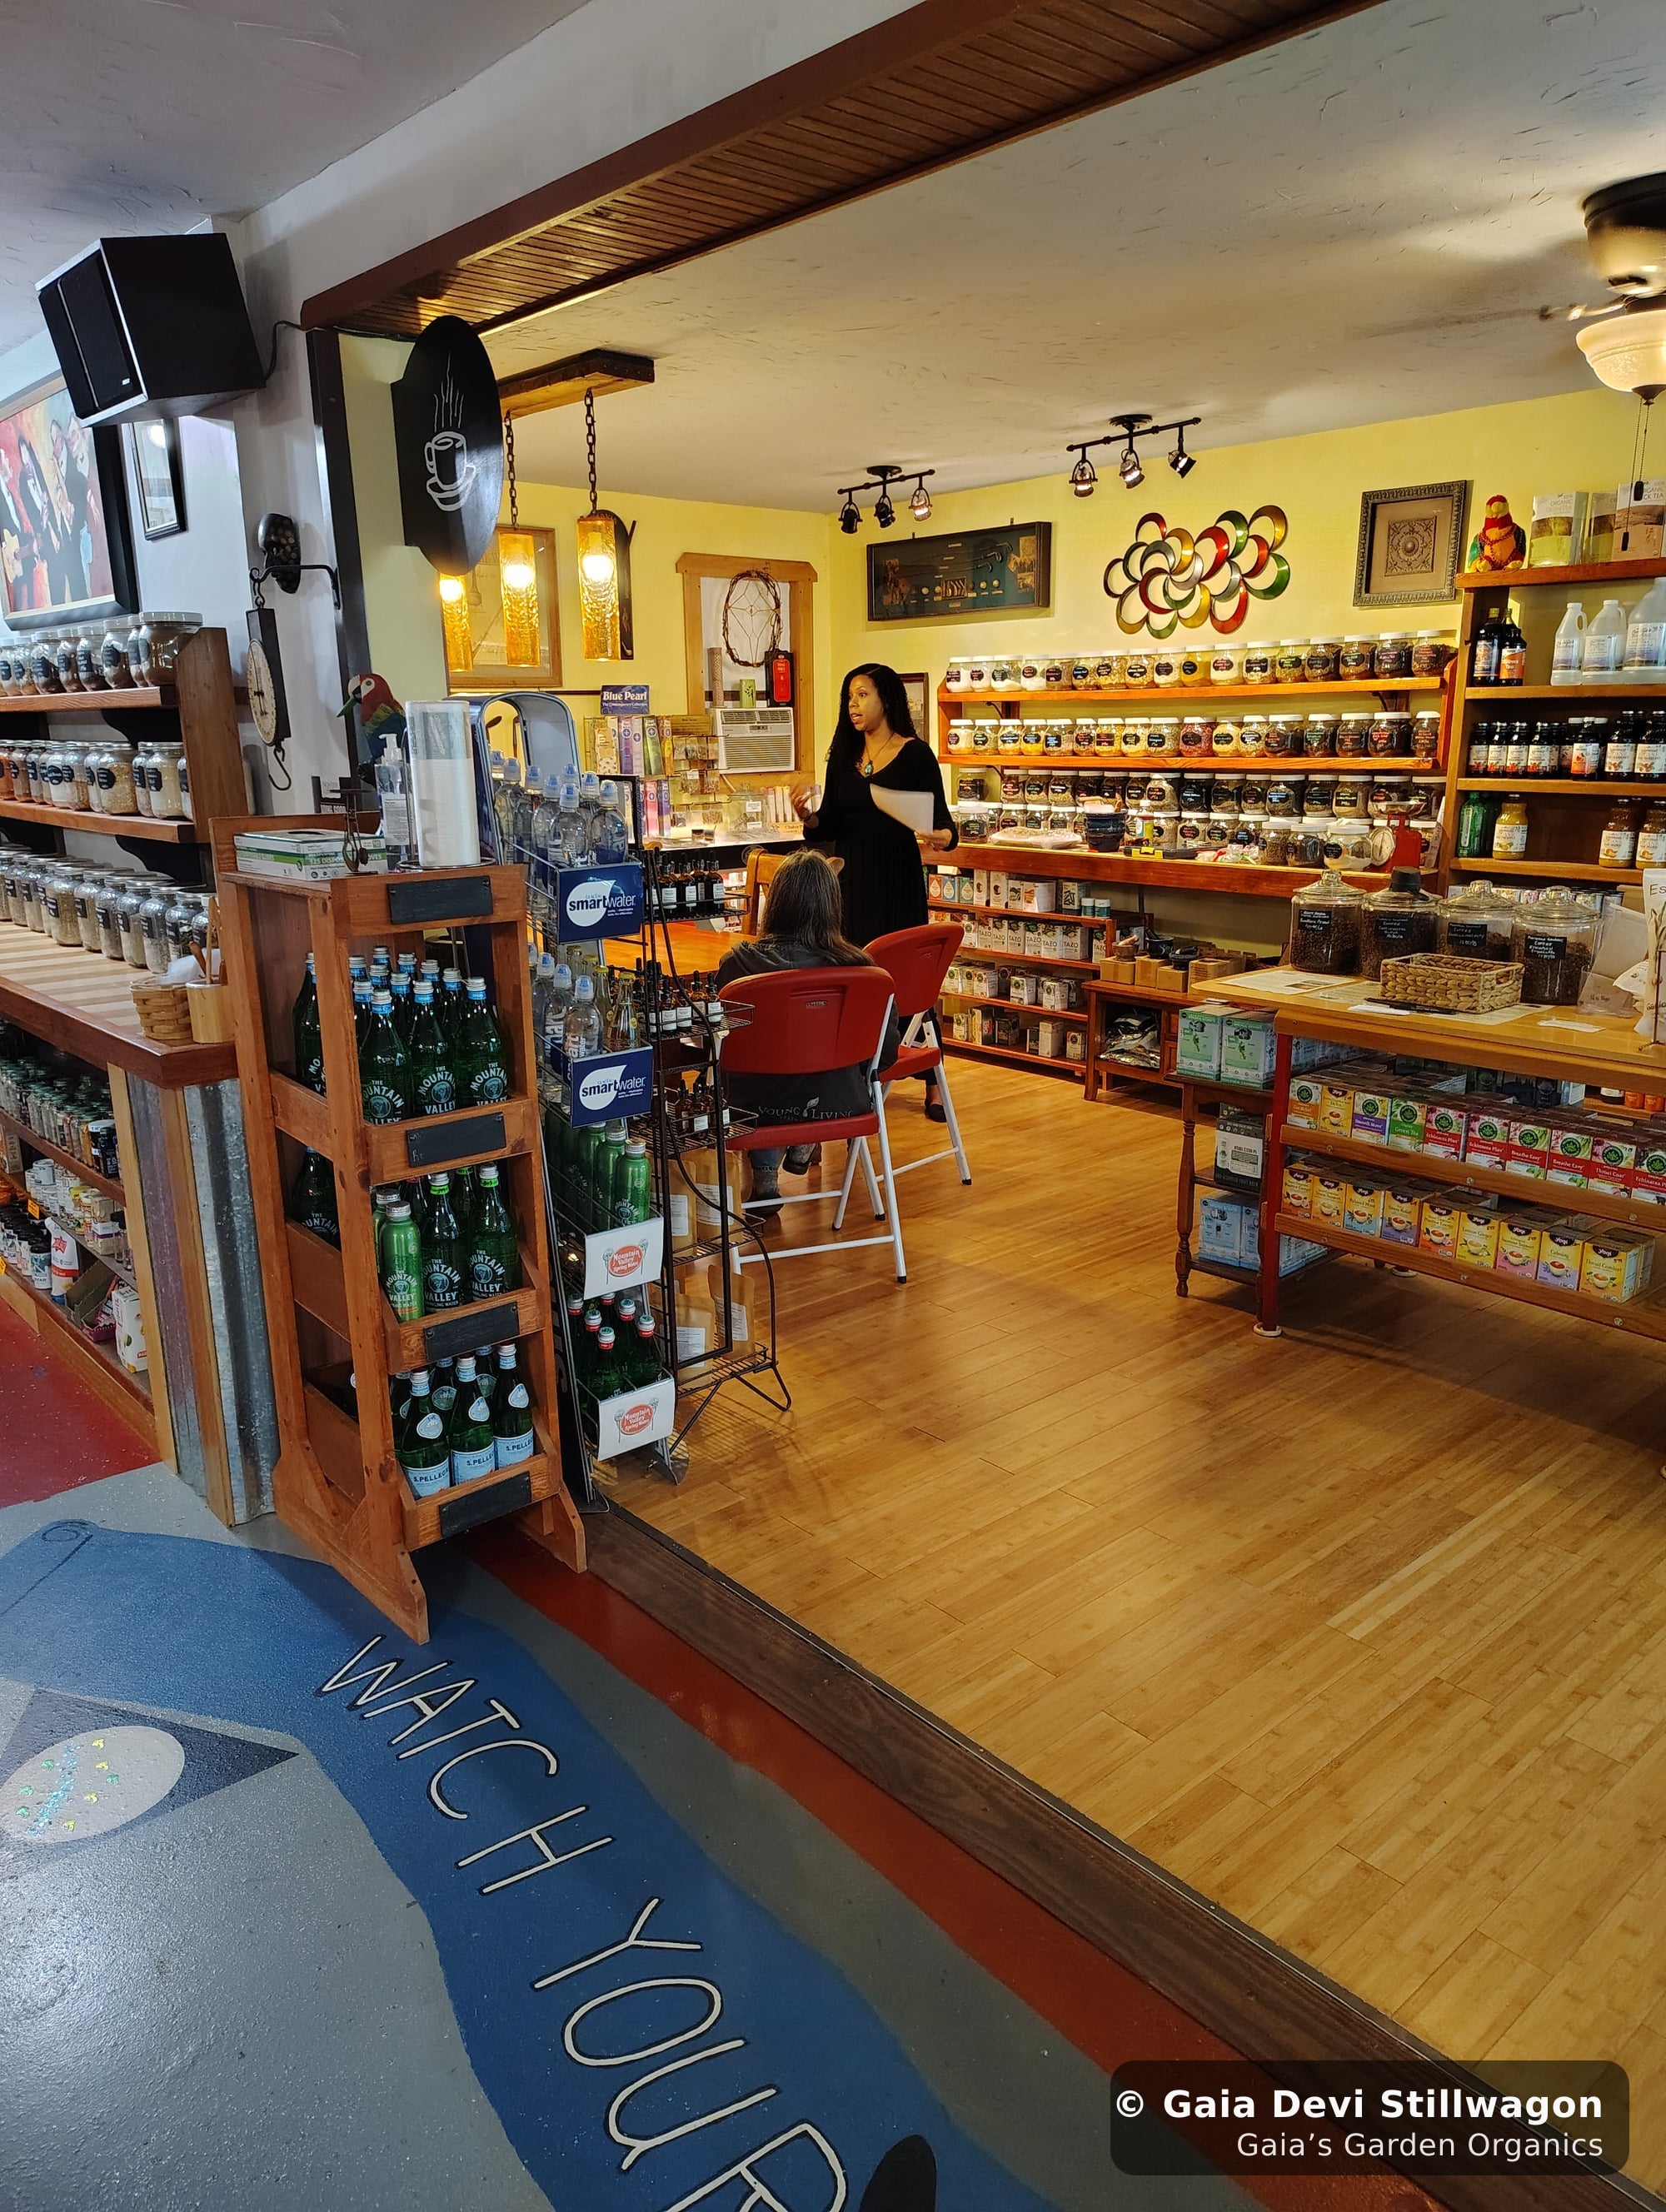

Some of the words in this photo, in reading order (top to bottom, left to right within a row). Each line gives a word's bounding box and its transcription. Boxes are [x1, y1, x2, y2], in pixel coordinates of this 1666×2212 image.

[602, 691, 623, 700] Blue
[624, 691, 647, 700] Pearl
[569, 894, 636, 911] smartwater
[581, 1077, 646, 1097] smartwater
[362, 1085, 405, 1108] OUNTAIN
[425, 1101, 456, 1114] VALLEY
[758, 1106, 801, 1116] YOUNG
[1511, 1150, 1529, 1158] Breathe
[1553, 1158, 1571, 1168] Breathe
[1595, 1168, 1611, 1176] Throat
[1434, 1207, 1447, 1215] yogi
[1473, 1216, 1485, 1224] yogi
[302, 1218, 338, 1235] UNTAIN
[1513, 1226, 1526, 1235] yogi
[1555, 1236, 1569, 1245] yogi
[613, 1249, 641, 1265] Mountain
[1599, 1248, 1612, 1258] yogi
[470, 1254, 506, 1275] OUNTAIN
[618, 1257, 634, 1265] Valley
[422, 1263, 461, 1284] OUNTAIN
[389, 1293, 415, 1302] VALLEY
[424, 1291, 456, 1302] VALLEY
[624, 1407, 651, 1424] Mountain
[625, 1423, 640, 1432] Spring
[466, 1452, 494, 1467] S.PELLE
[412, 1468, 449, 1482] S.PELLEG
[318, 1634, 616, 1896] WATCH
[531, 1896, 850, 2212] YOUR
